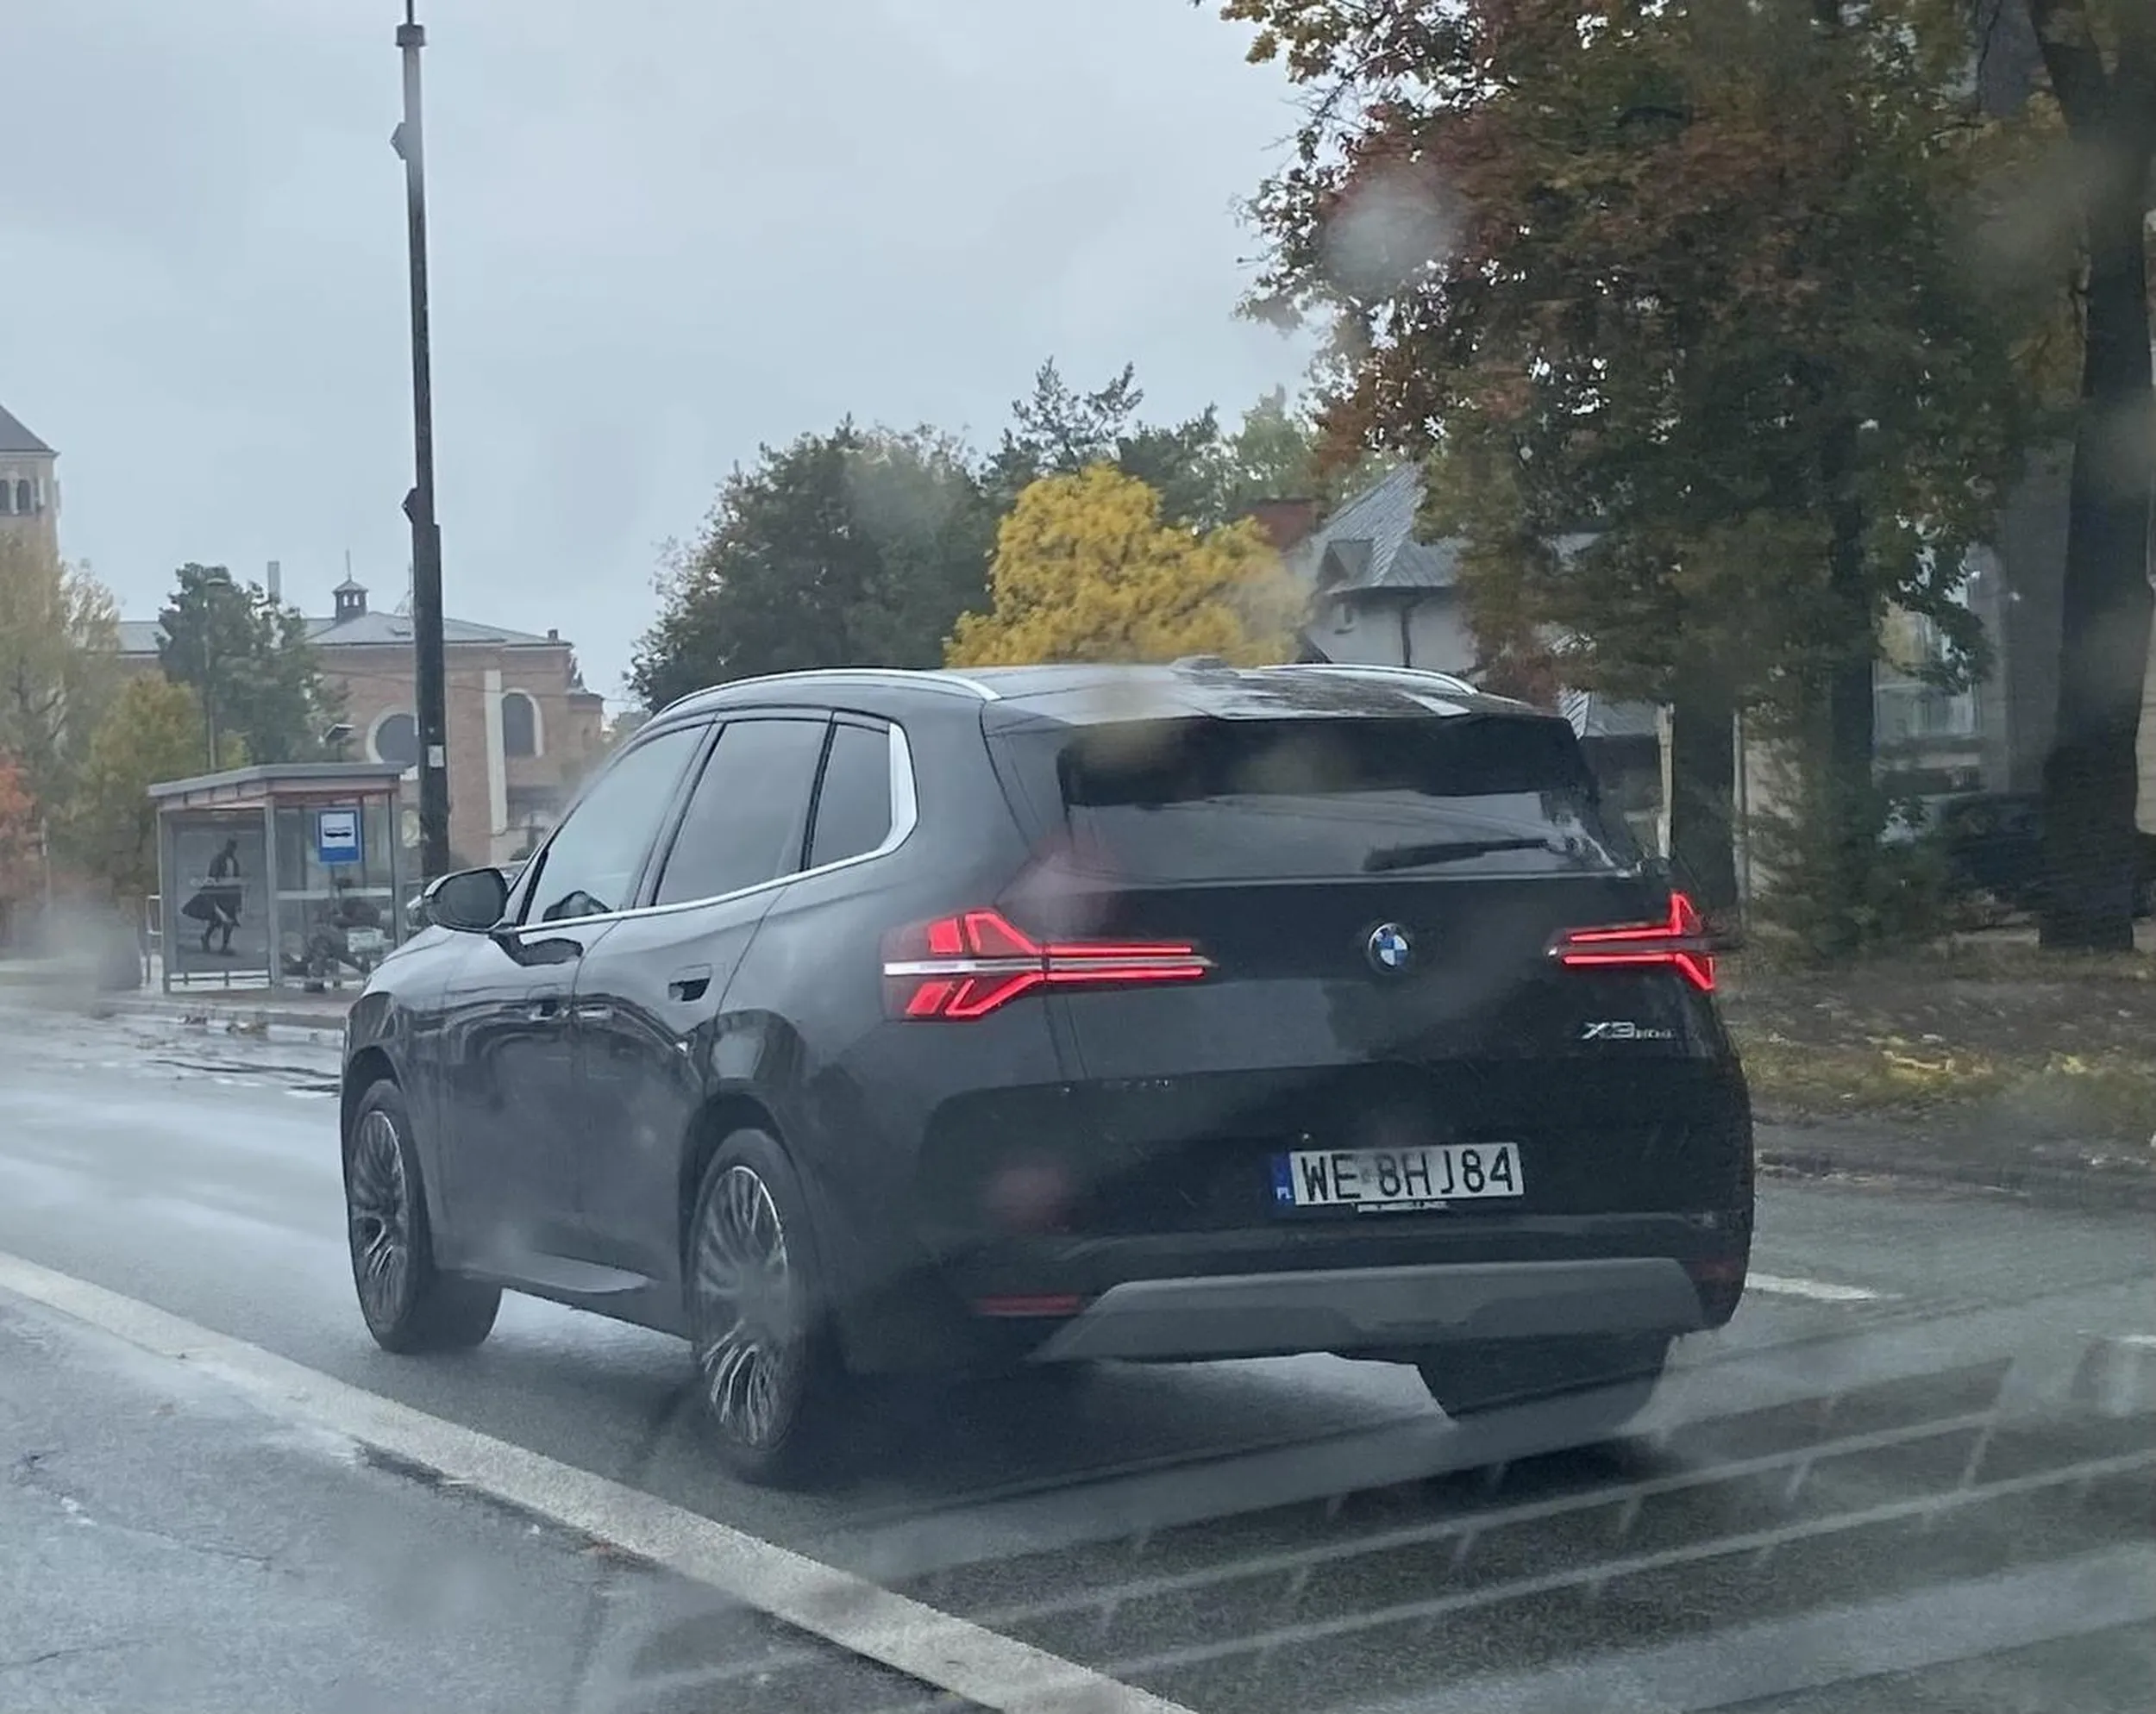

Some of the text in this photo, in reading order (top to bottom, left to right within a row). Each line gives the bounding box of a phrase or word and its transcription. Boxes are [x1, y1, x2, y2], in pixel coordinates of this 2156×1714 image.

[1582, 1022, 1636, 1040] X3
[1300, 1146, 1514, 1202] WE 8HJ84
